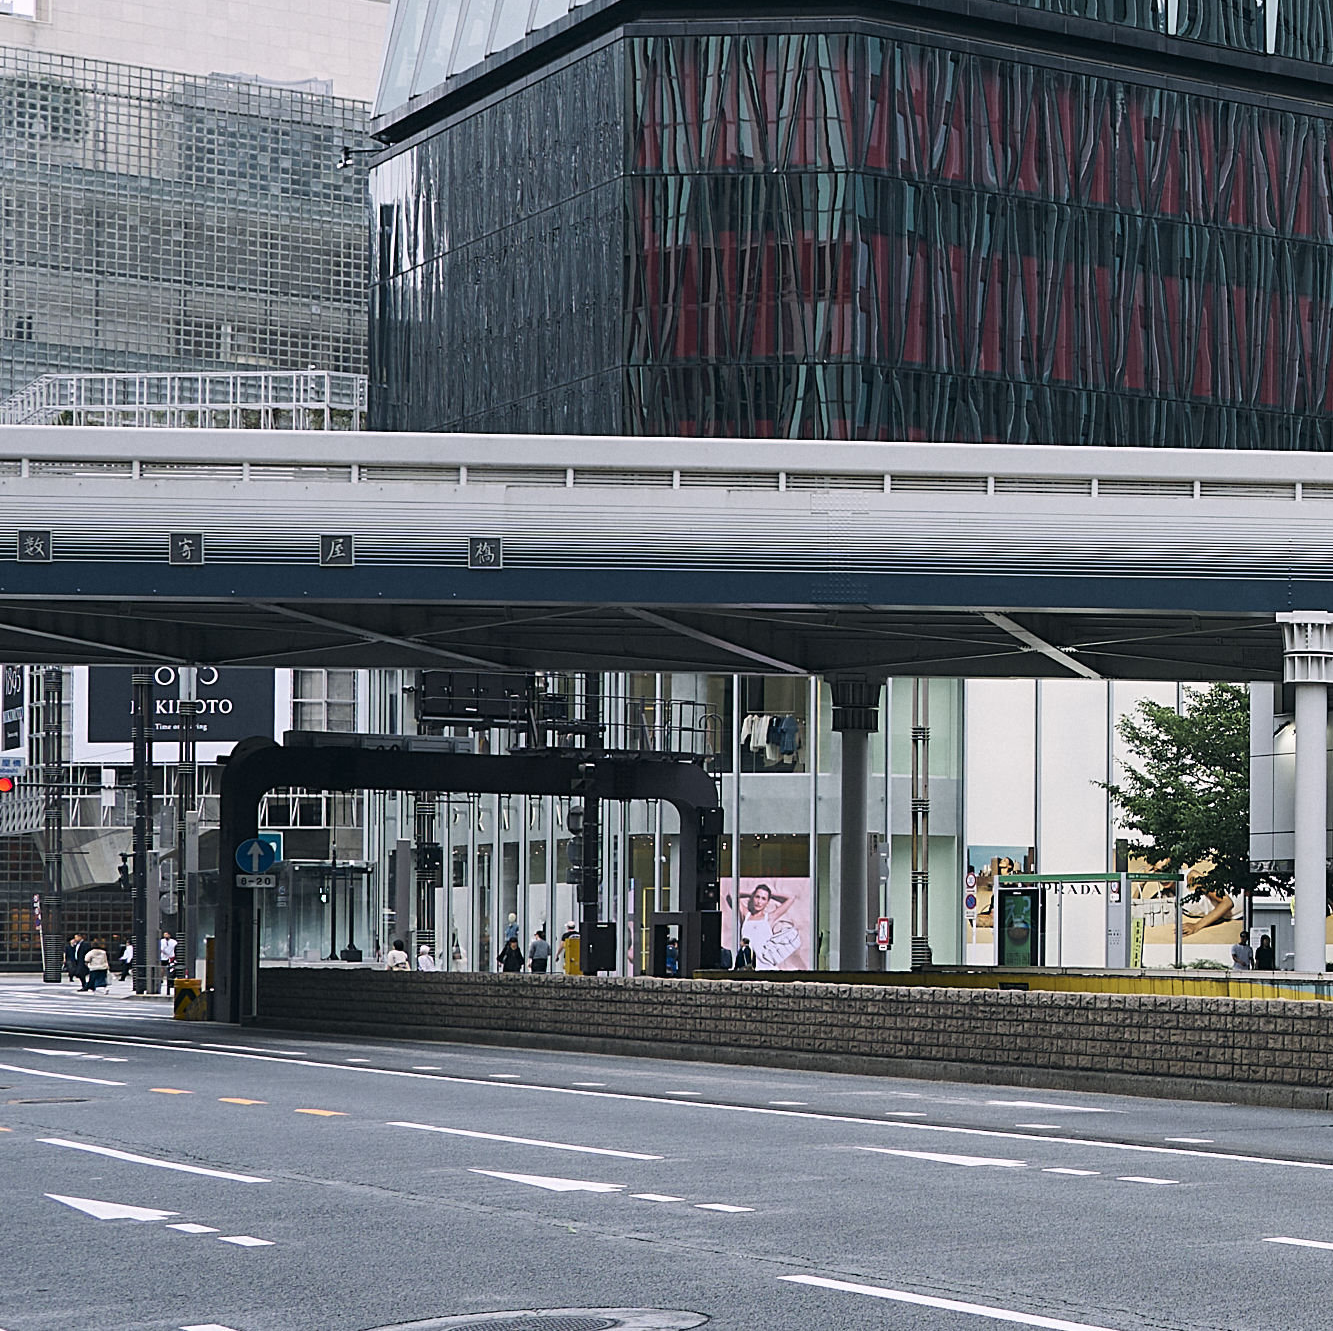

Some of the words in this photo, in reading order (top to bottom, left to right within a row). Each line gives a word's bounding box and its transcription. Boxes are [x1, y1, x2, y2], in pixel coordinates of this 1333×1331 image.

[24, 536, 46, 557] 数
[178, 536, 197, 561] 寄
[325, 538, 345, 562] 屋
[475, 541, 496, 564] 橋
[1043, 882, 1102, 895] PRADA
